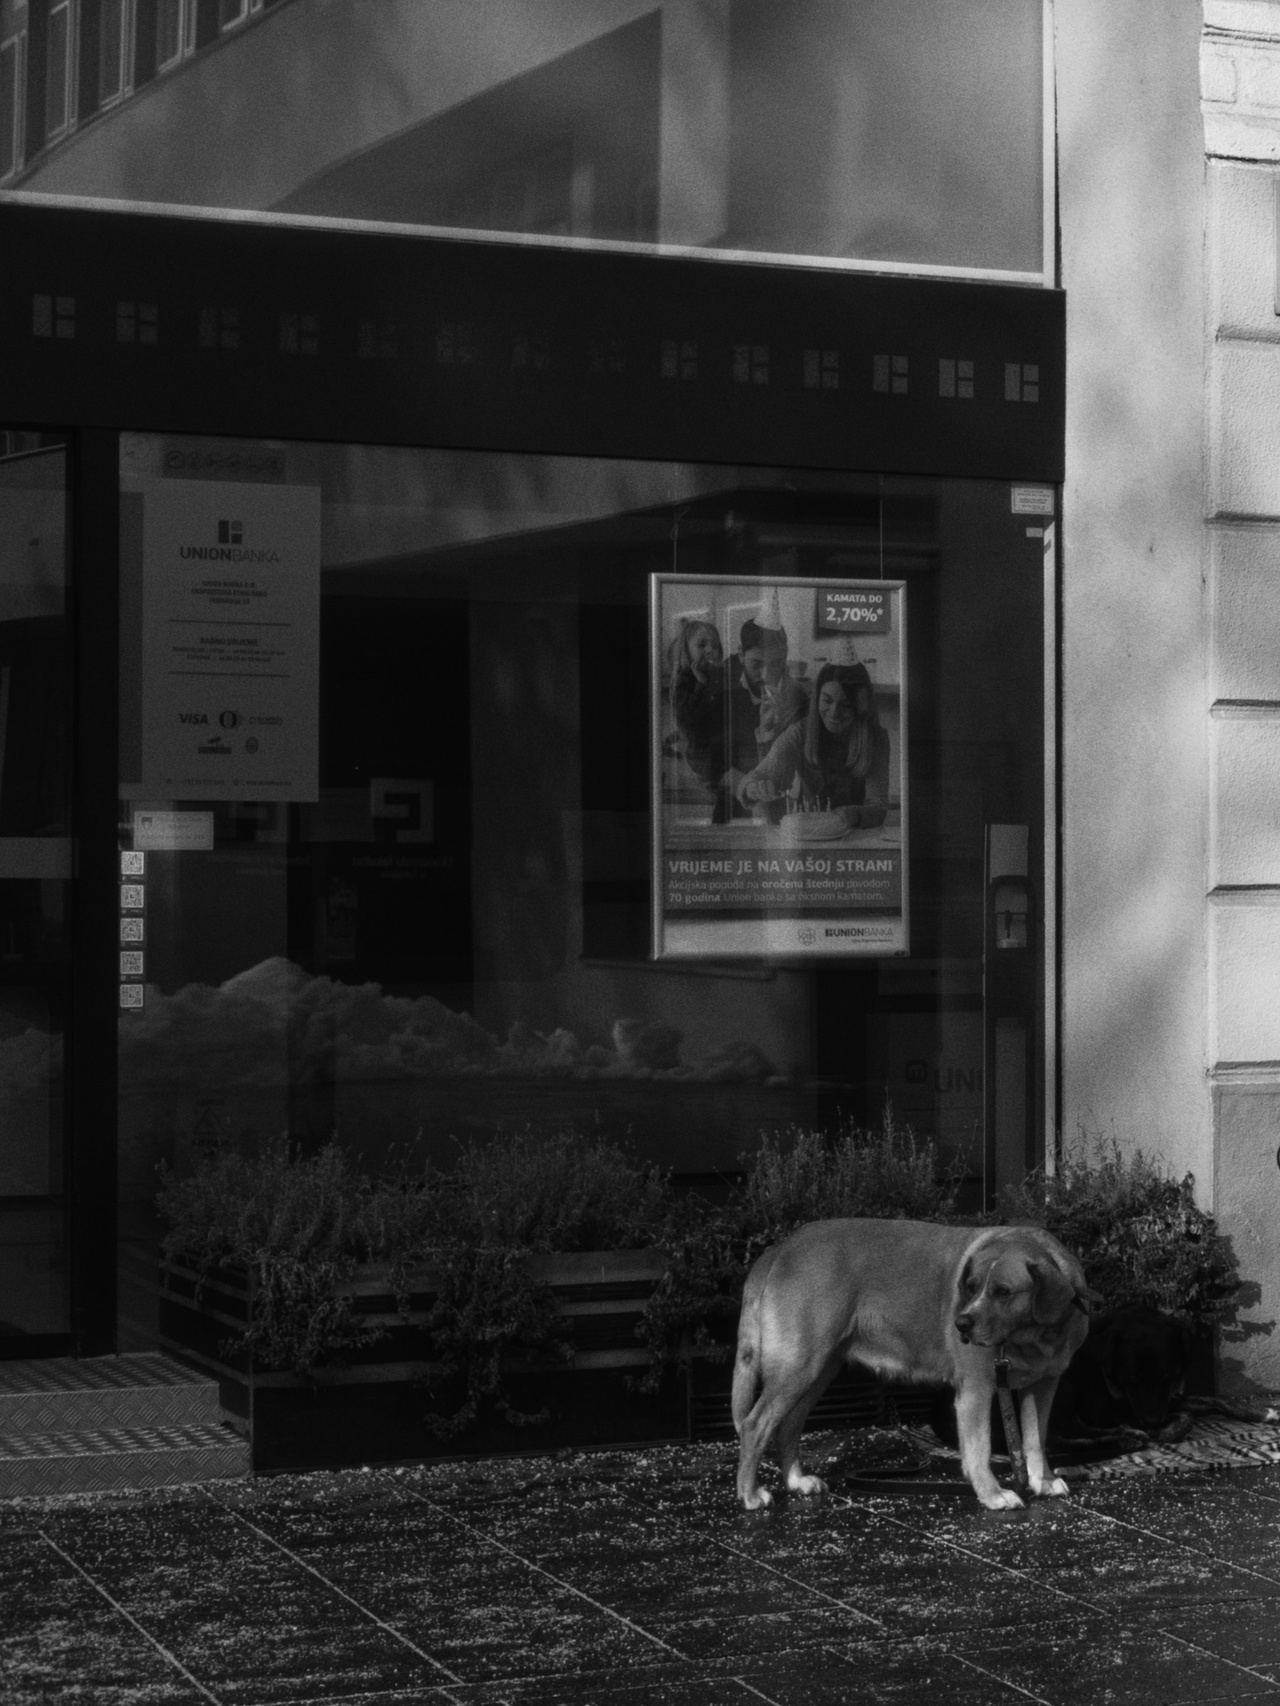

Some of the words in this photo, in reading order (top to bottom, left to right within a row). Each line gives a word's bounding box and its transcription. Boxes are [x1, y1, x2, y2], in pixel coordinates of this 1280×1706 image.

[179, 546, 279, 563] UNIONBANKA
[826, 594, 866, 603] KAMATA
[869, 595, 883, 604] DO
[178, 713, 209, 725] VISA
[669, 860, 733, 875] VRIJEME
[737, 860, 753, 875] JE
[757, 860, 780, 873] NA
[785, 856, 832, 875] VAŠOJ
[836, 859, 893, 872] STRANI
[669, 880, 707, 891] Akcijska
[709, 880, 744, 891] ponuda
[747, 881, 759, 889] na
[762, 878, 803, 889] oročenu
[806, 878, 844, 891] štednju
[846, 879, 891, 890] povodom
[669, 893, 682, 902] 70
[685, 892, 721, 905] godina
[723, 892, 751, 902] Union
[753, 892, 783, 901] banke
[785, 893, 796, 901] sa
[798, 892, 836, 901] fiksnom
[833, 927, 893, 937] UNIONBANKA
